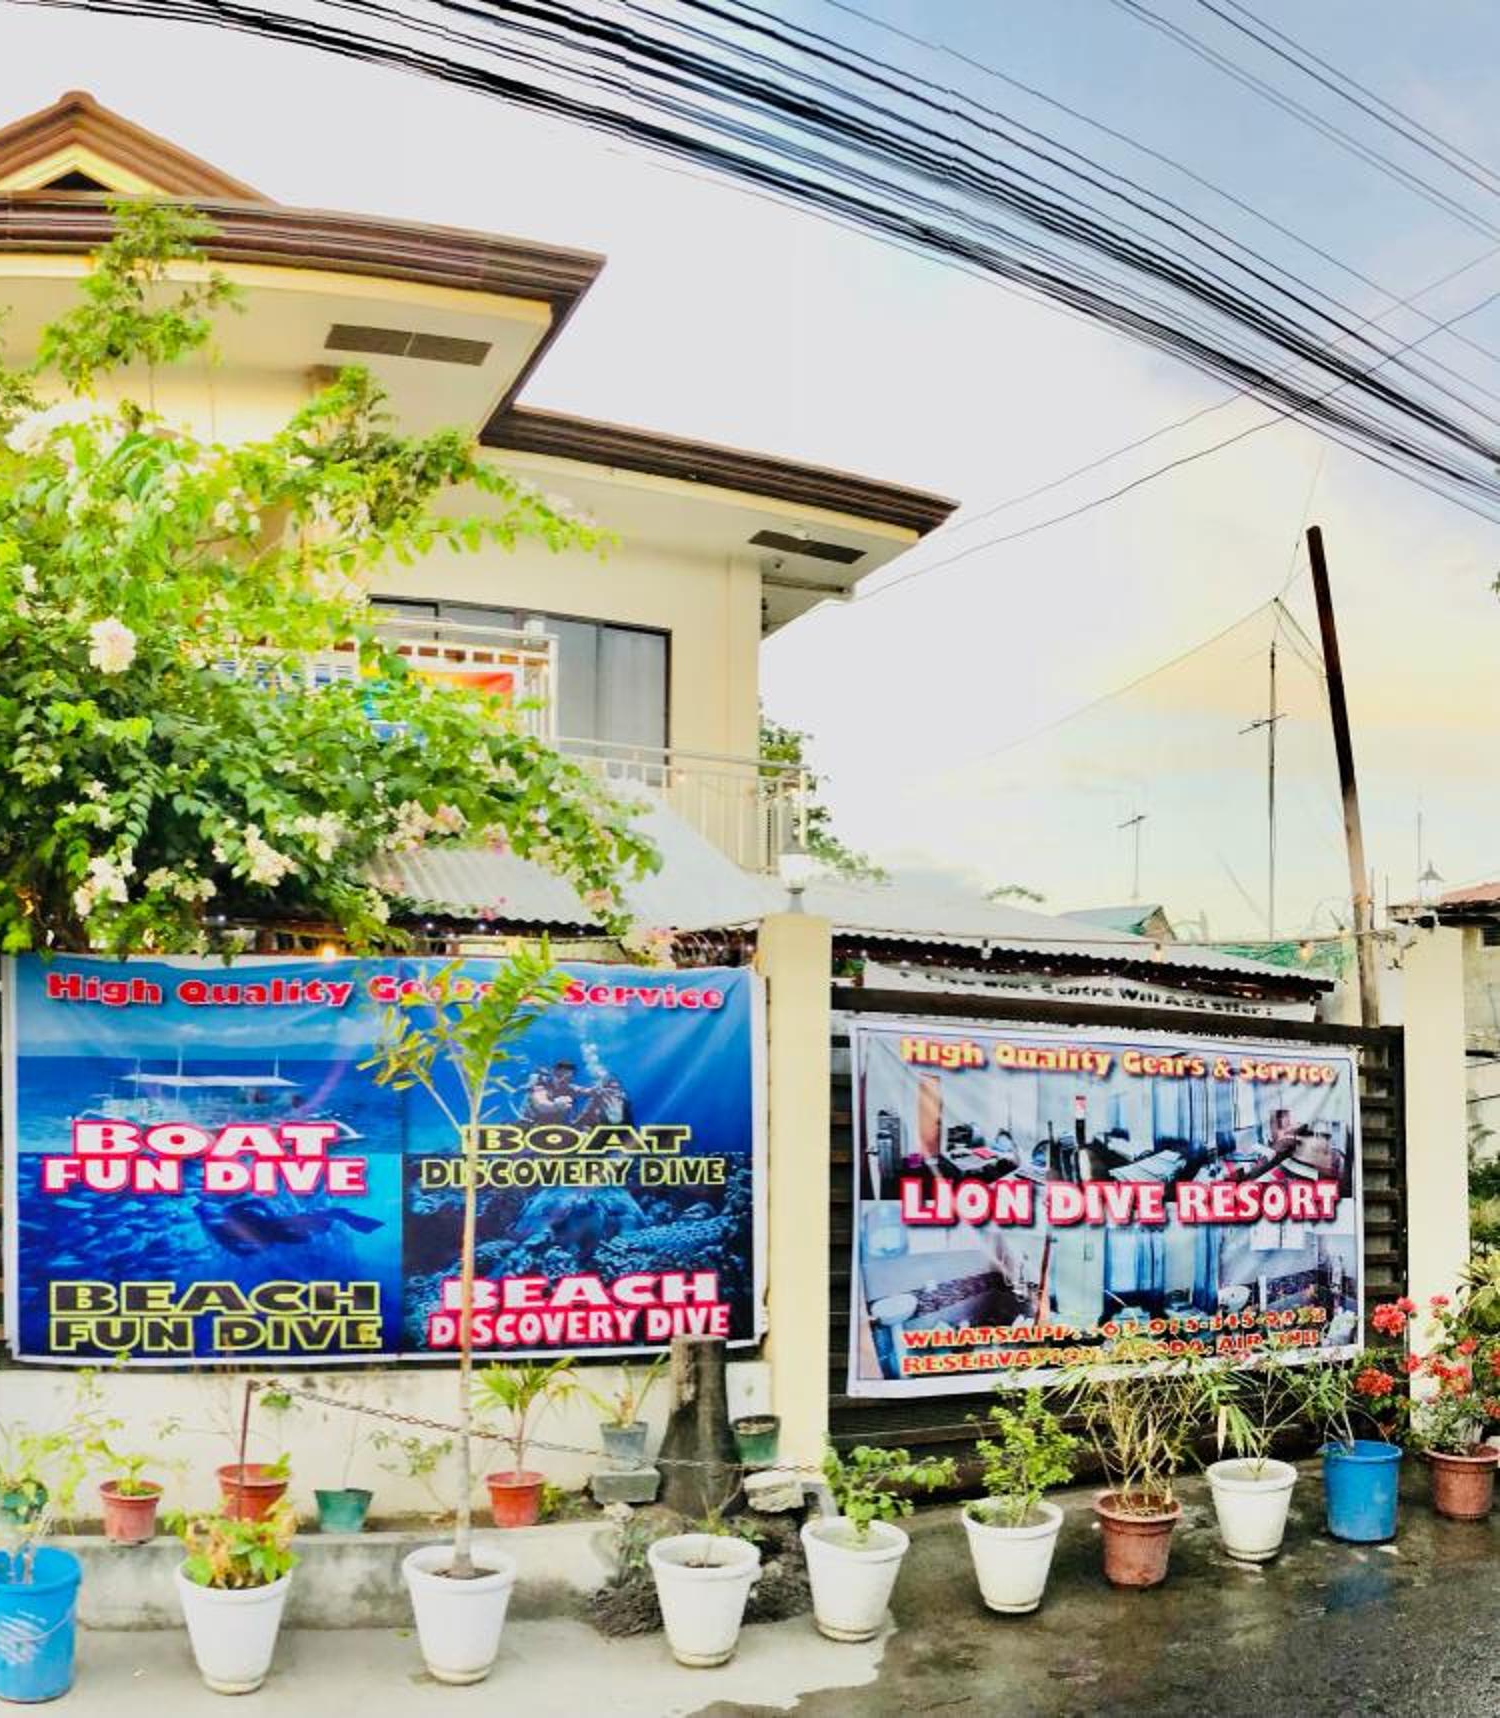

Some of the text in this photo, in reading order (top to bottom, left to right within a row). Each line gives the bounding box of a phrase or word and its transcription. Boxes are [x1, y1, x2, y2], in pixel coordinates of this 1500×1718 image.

[47, 973, 163, 1005] High
[176, 977, 355, 1007] Quality
[564, 979, 725, 1010] Service
[1119, 987, 1160, 1003] Will
[901, 1037, 1339, 1085] High Quality Gears & Service
[72, 1120, 340, 1157] BOAT
[462, 1125, 691, 1154] BOAT
[41, 1155, 368, 1196] FUN DIVE
[421, 1157, 726, 1189] DISCOVERY DIVE
[901, 1177, 1340, 1227] LION DIVE RESORT
[49, 1280, 381, 1316] BEACH
[441, 1271, 719, 1311] BEACH
[51, 1316, 383, 1351] FUN DIVE
[646, 1304, 731, 1341] DIVE
